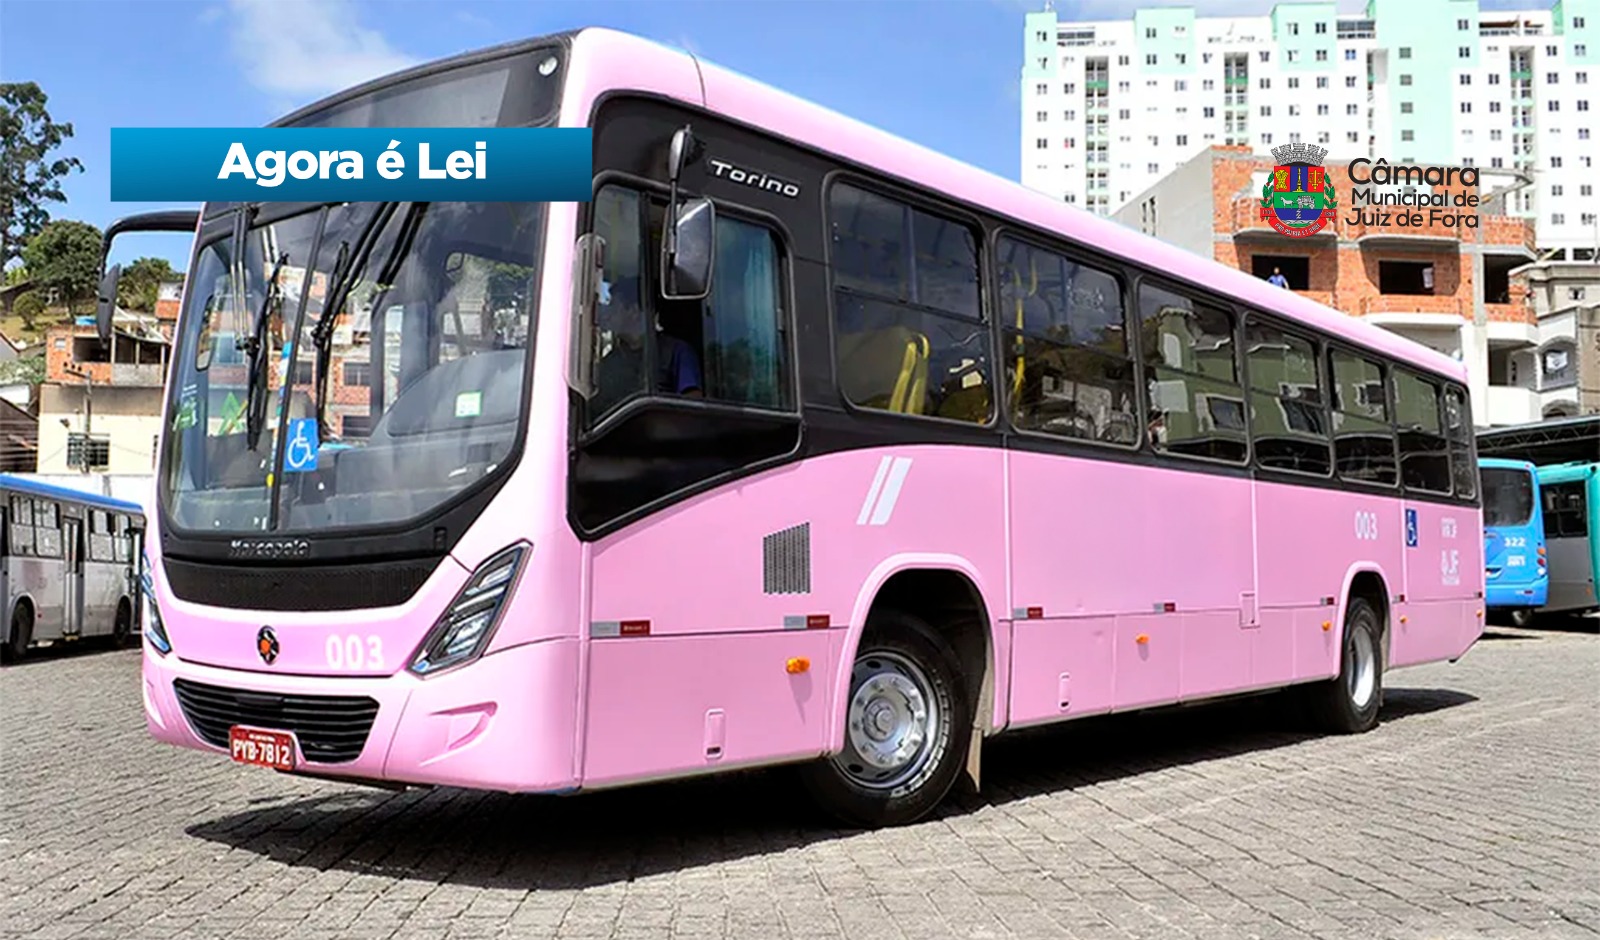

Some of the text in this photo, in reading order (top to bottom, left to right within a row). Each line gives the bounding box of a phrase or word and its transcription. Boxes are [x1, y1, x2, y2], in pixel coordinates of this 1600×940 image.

[711, 160, 799, 197] Torino
[1355, 511, 1377, 540] 003
[1504, 537, 1526, 547] 322
[325, 634, 385, 670] 003
[233, 739, 290, 765] PYB-7812
